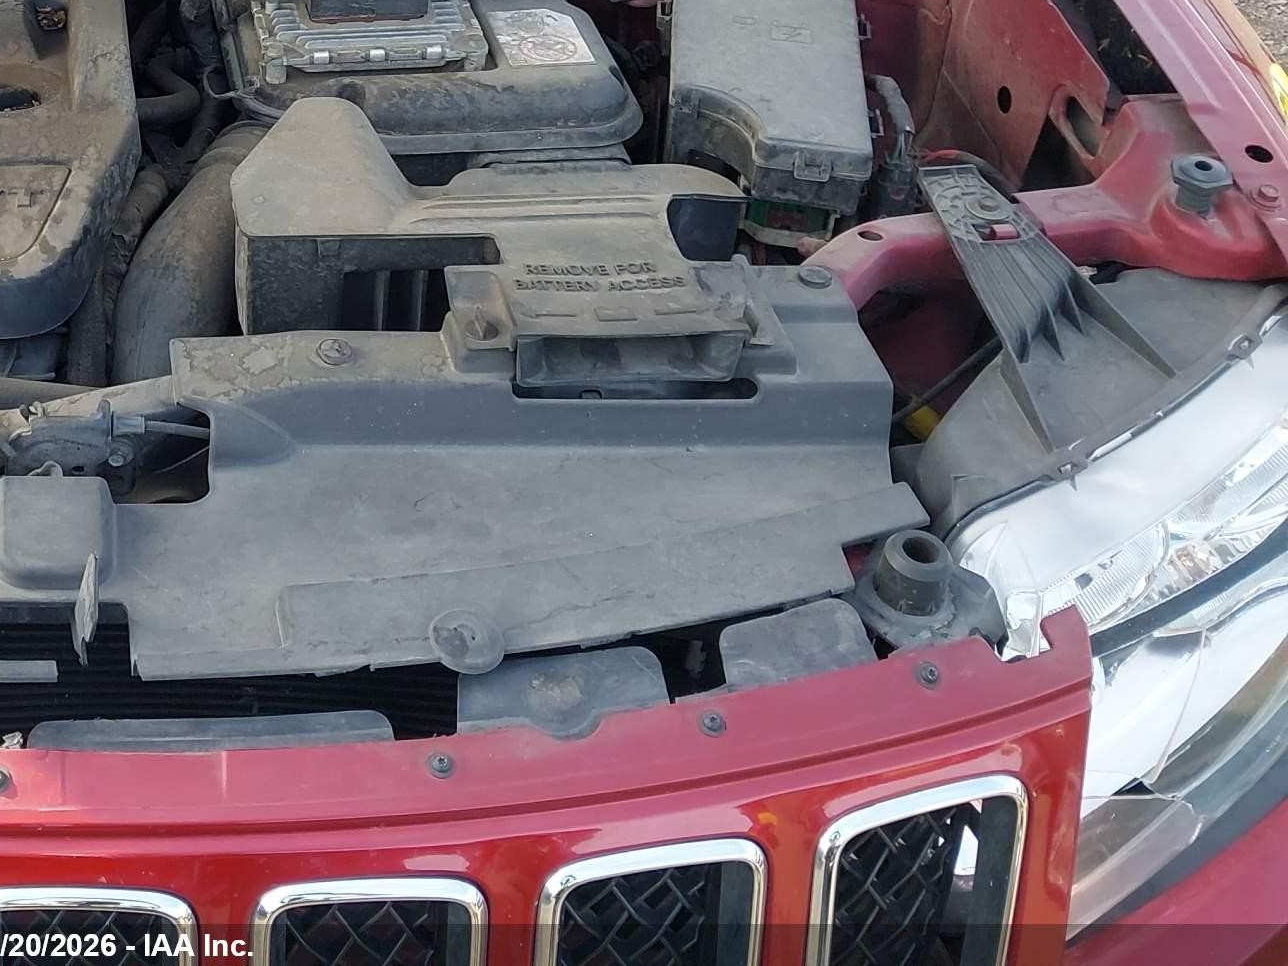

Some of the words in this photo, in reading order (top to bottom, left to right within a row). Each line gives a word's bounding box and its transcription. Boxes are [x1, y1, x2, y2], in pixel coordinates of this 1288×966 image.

[525, 262, 610, 277] REMOVE
[614, 261, 658, 276] FOR
[515, 277, 602, 292] BATTERY
[607, 274, 689, 292] ACCESS
